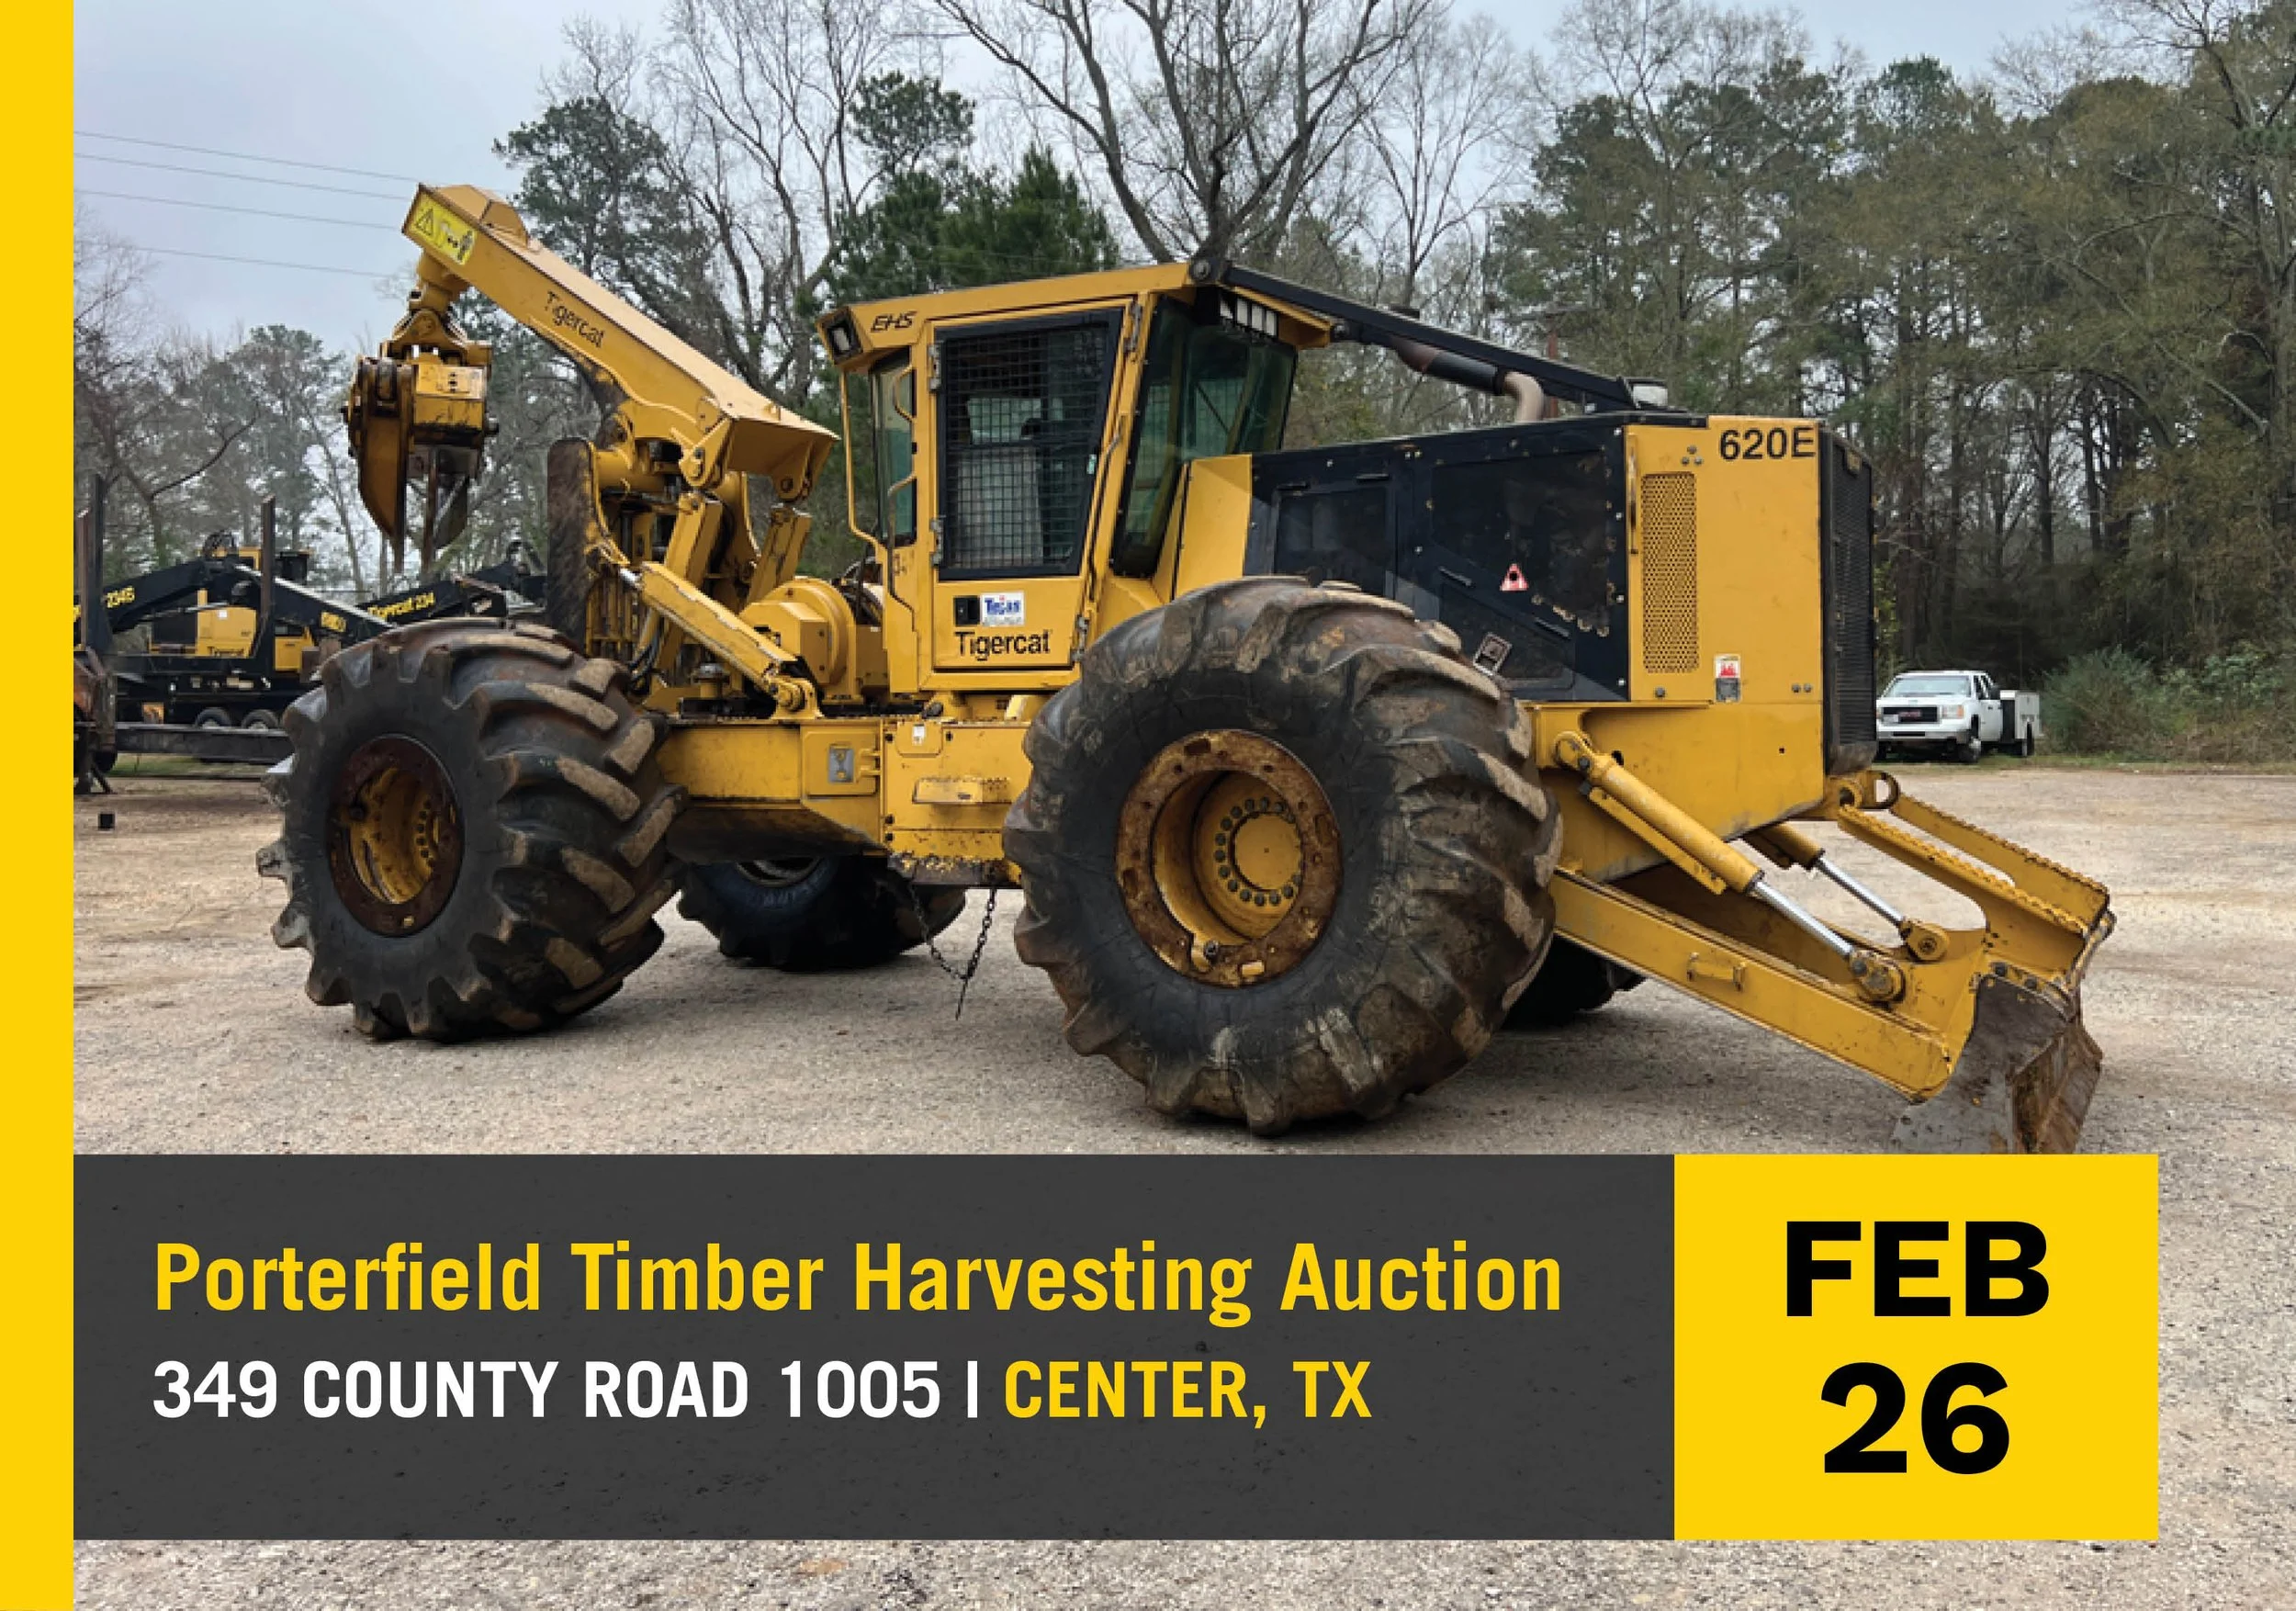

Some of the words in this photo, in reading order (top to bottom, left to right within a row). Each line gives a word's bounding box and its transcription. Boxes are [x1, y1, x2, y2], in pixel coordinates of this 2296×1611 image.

[546, 290, 605, 349] Tigercat
[1719, 426, 1817, 461] 620E
[954, 629, 1051, 661] Tigercat
